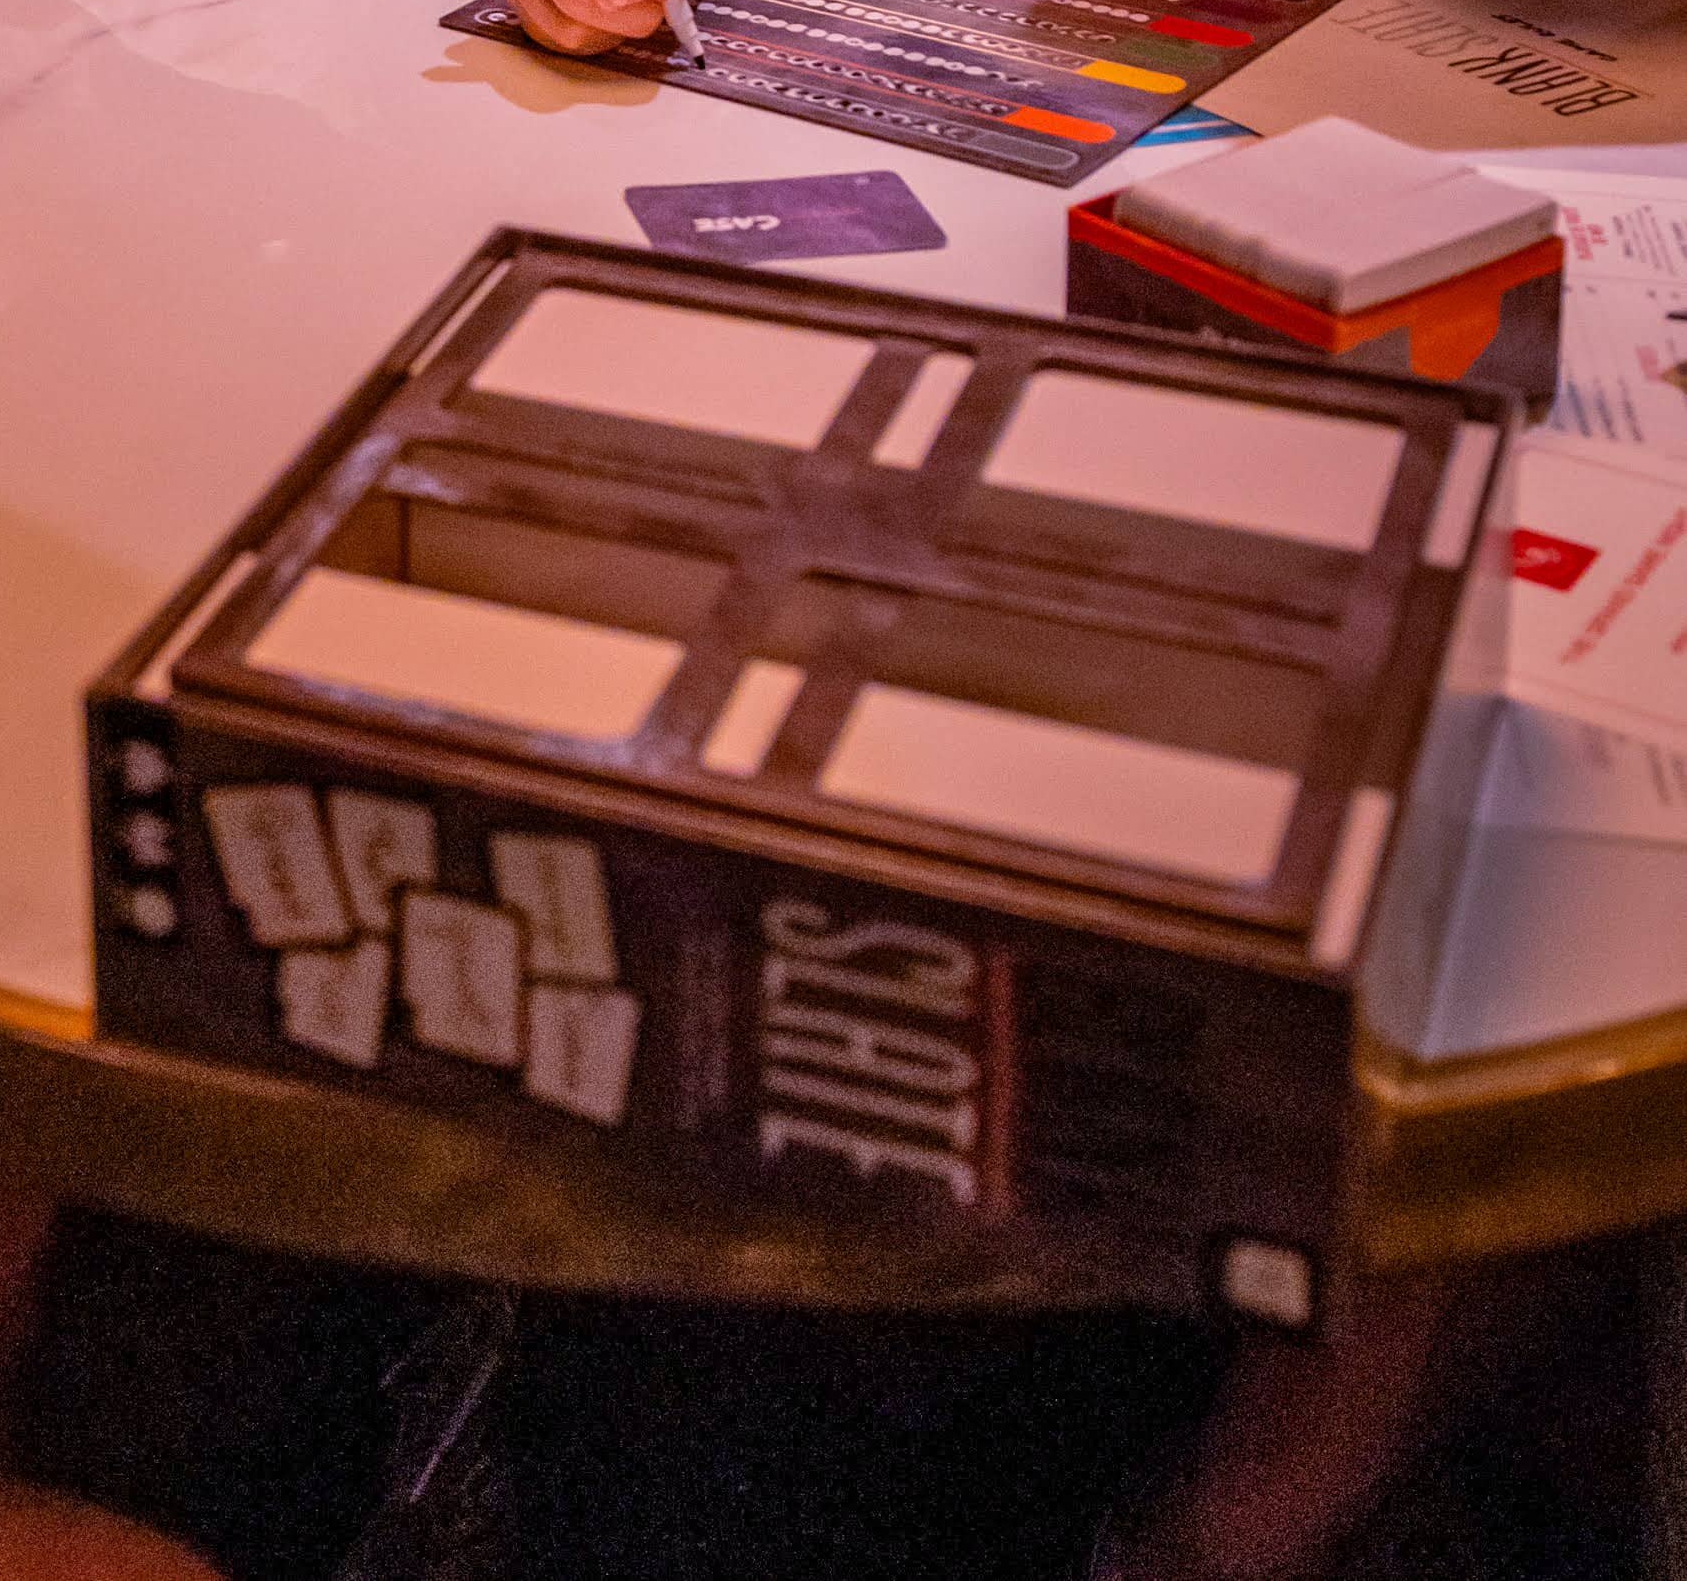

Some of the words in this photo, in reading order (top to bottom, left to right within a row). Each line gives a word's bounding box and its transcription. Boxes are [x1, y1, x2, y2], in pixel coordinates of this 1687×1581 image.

[1329, 1, 1502, 59] SLATE
[1448, 45, 1639, 118] BLANK
[759, 896, 976, 1207] SLATE
